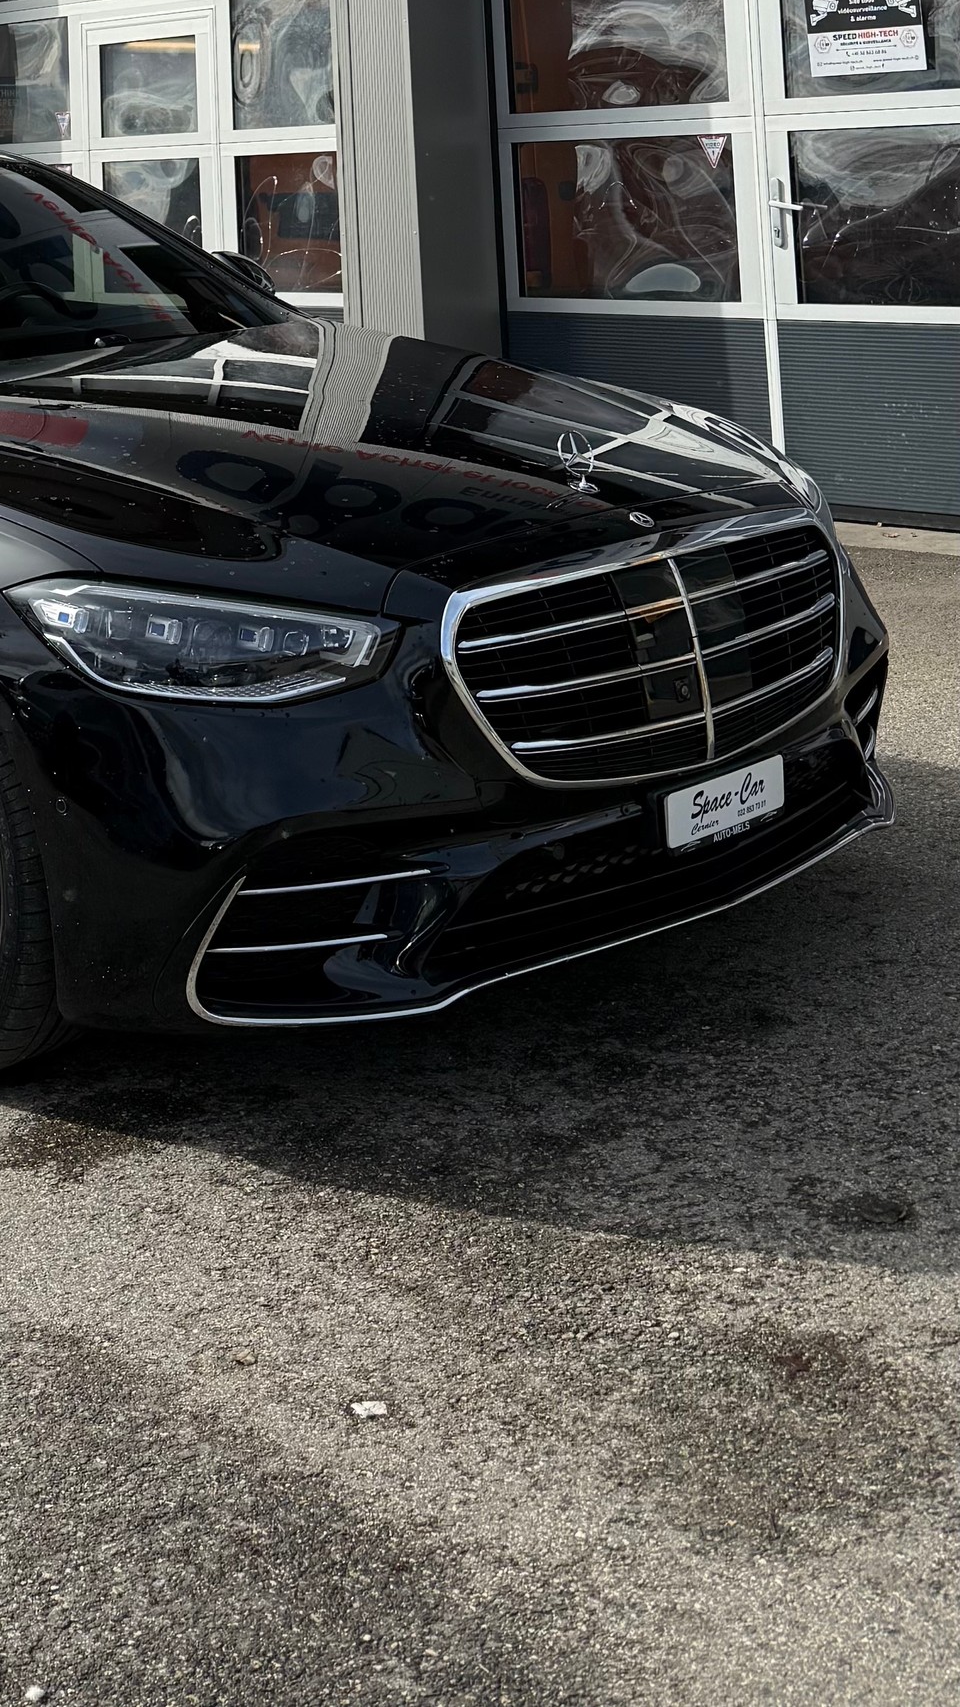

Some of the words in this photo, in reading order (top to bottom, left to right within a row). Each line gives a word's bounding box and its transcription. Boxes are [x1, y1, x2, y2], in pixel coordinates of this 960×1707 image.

[832, 32, 857, 42] SPEED
[857, 30, 899, 40] HIGH-TECH
[691, 819, 719, 836] Cernier
